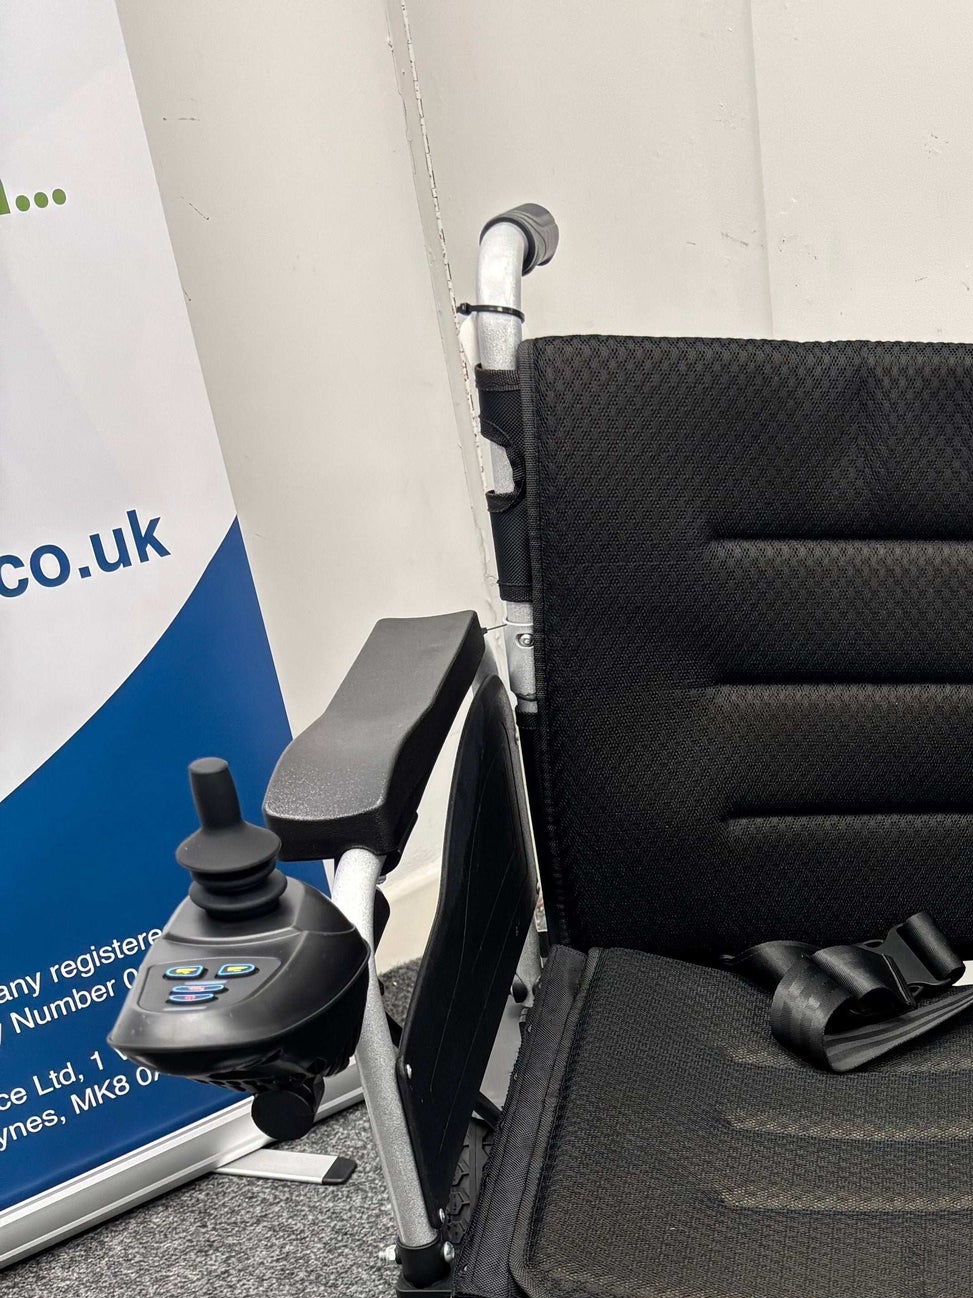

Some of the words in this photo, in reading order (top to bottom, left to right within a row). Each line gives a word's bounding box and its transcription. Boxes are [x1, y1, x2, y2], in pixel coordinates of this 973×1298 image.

[0, 509, 171, 598] co.uk
[0, 971, 41, 1004] any
[10, 979, 116, 1034] Number
[32, 1062, 84, 1096] Ltd,
[90, 1051, 104, 1071] 1
[70, 1075, 130, 1115] MK8
